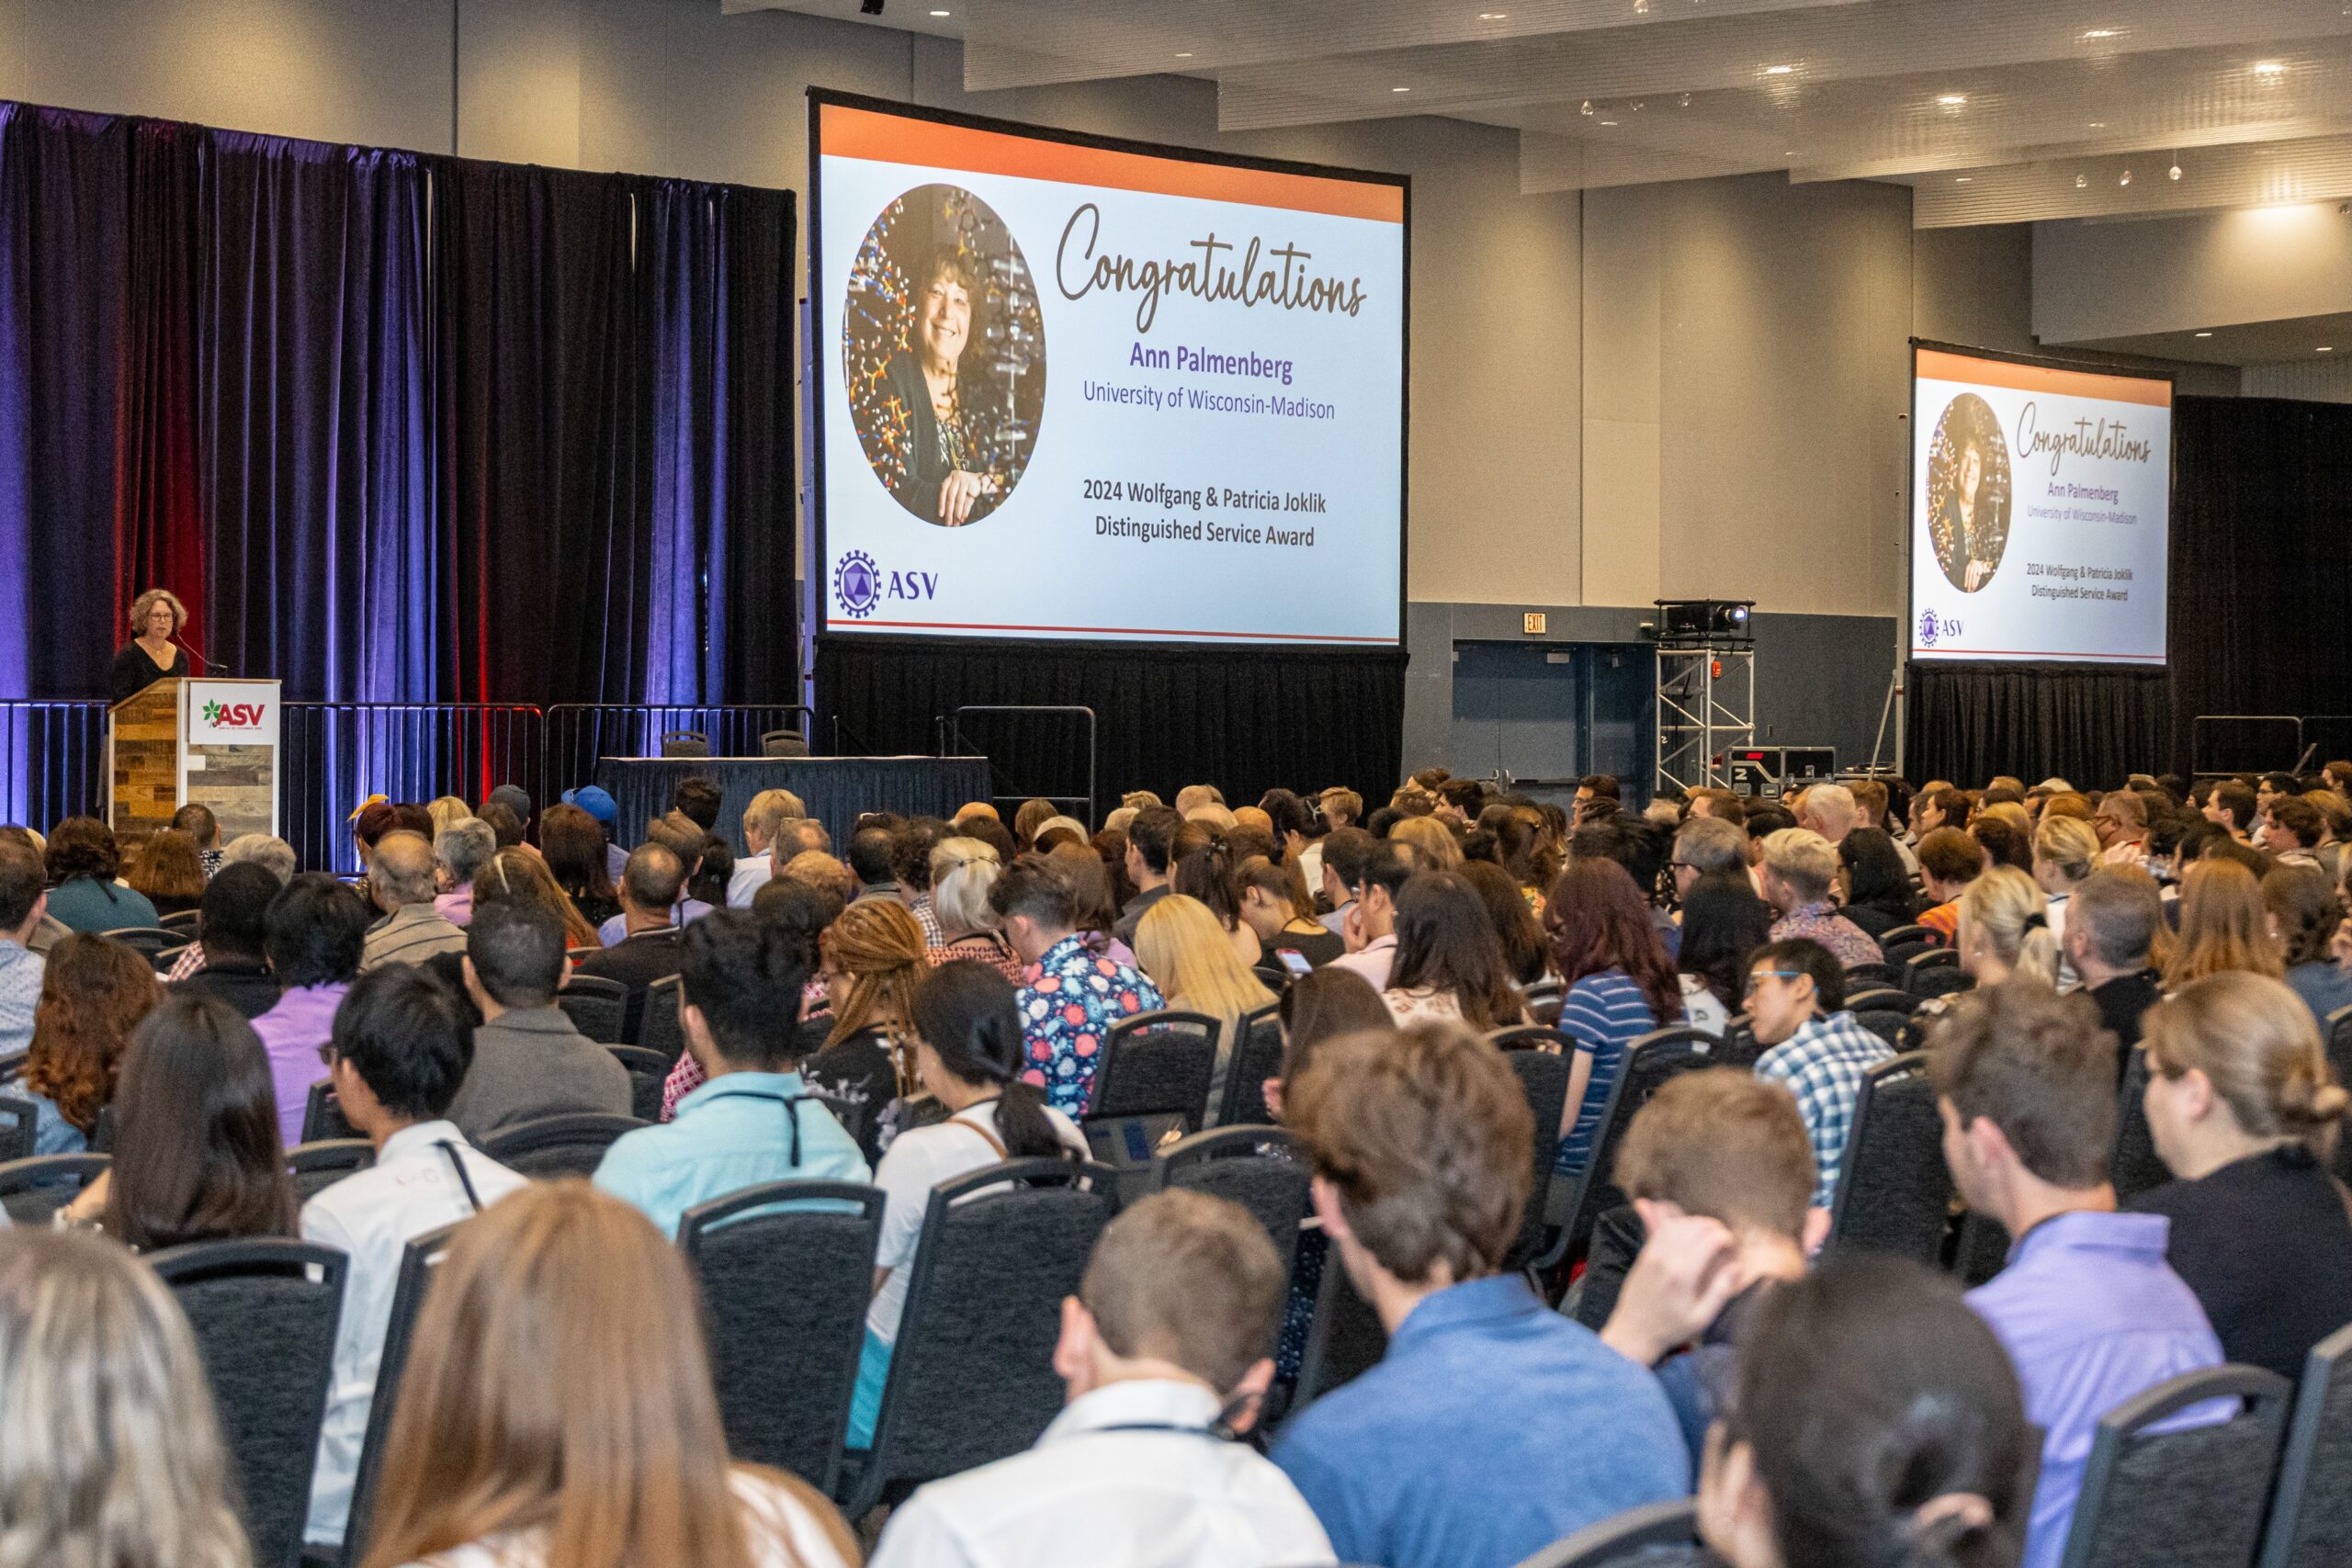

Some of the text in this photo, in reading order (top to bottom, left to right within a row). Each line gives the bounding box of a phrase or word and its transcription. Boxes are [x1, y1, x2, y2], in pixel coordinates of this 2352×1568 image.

[1057, 203, 1367, 333] Congratulations
[1130, 342, 1293, 385] Ann Palmenberg
[1084, 380, 1335, 420] University of Wisconsin-Madison
[2017, 401, 2151, 477] Congratulations
[1083, 479, 1326, 513] 2024 Wolfgang & Patricia Joklik
[2048, 481, 2119, 505] Ann Palmenberg
[2027, 504, 2063, 521] University
[2064, 507, 2072, 520] of
[1095, 515, 1315, 547] Distinguished Service Award
[888, 570, 938, 601] ASV
[2027, 563, 2044, 576] 2024
[2046, 564, 2078, 581] Wolfgang
[2080, 566, 2086, 578] &
[2087, 567, 2112, 580] Patricia
[2032, 584, 2128, 601] Distinguished Service Award
[1528, 615, 1543, 631] EXIT
[1942, 619, 1964, 637] ASV
[216, 704, 266, 726] ASV
